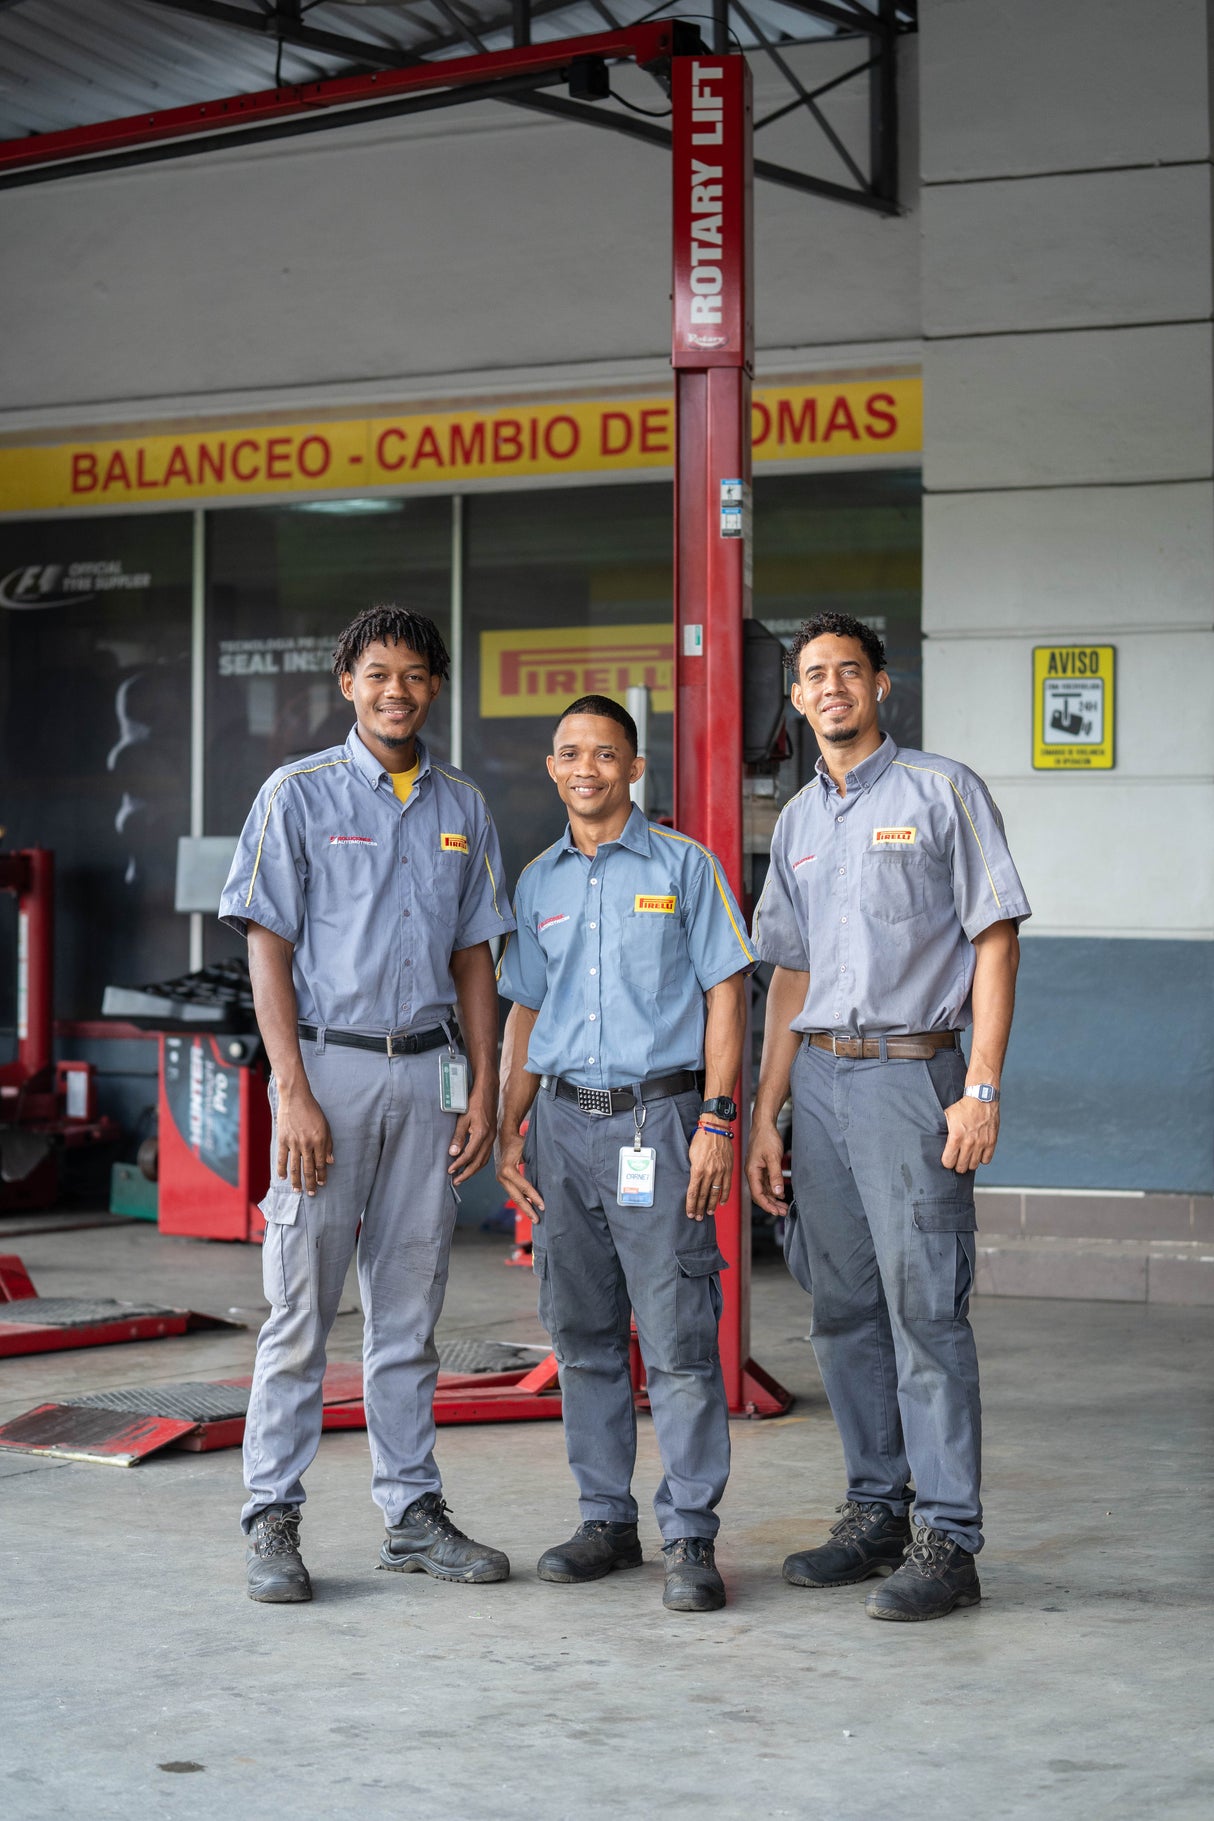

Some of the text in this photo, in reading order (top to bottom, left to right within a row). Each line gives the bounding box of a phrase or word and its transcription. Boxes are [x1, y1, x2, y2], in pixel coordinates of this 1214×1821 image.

[690, 61, 724, 324] ROTARY LIFT
[71, 393, 898, 494] BALANCEO - CAMBIO DE OMAS
[219, 653, 279, 676] SEAL
[500, 644, 674, 696] PIRELL
[1048, 650, 1099, 675] AVISO
[876, 830, 911, 841] PIRELLI
[639, 898, 674, 910] PIRELLI
